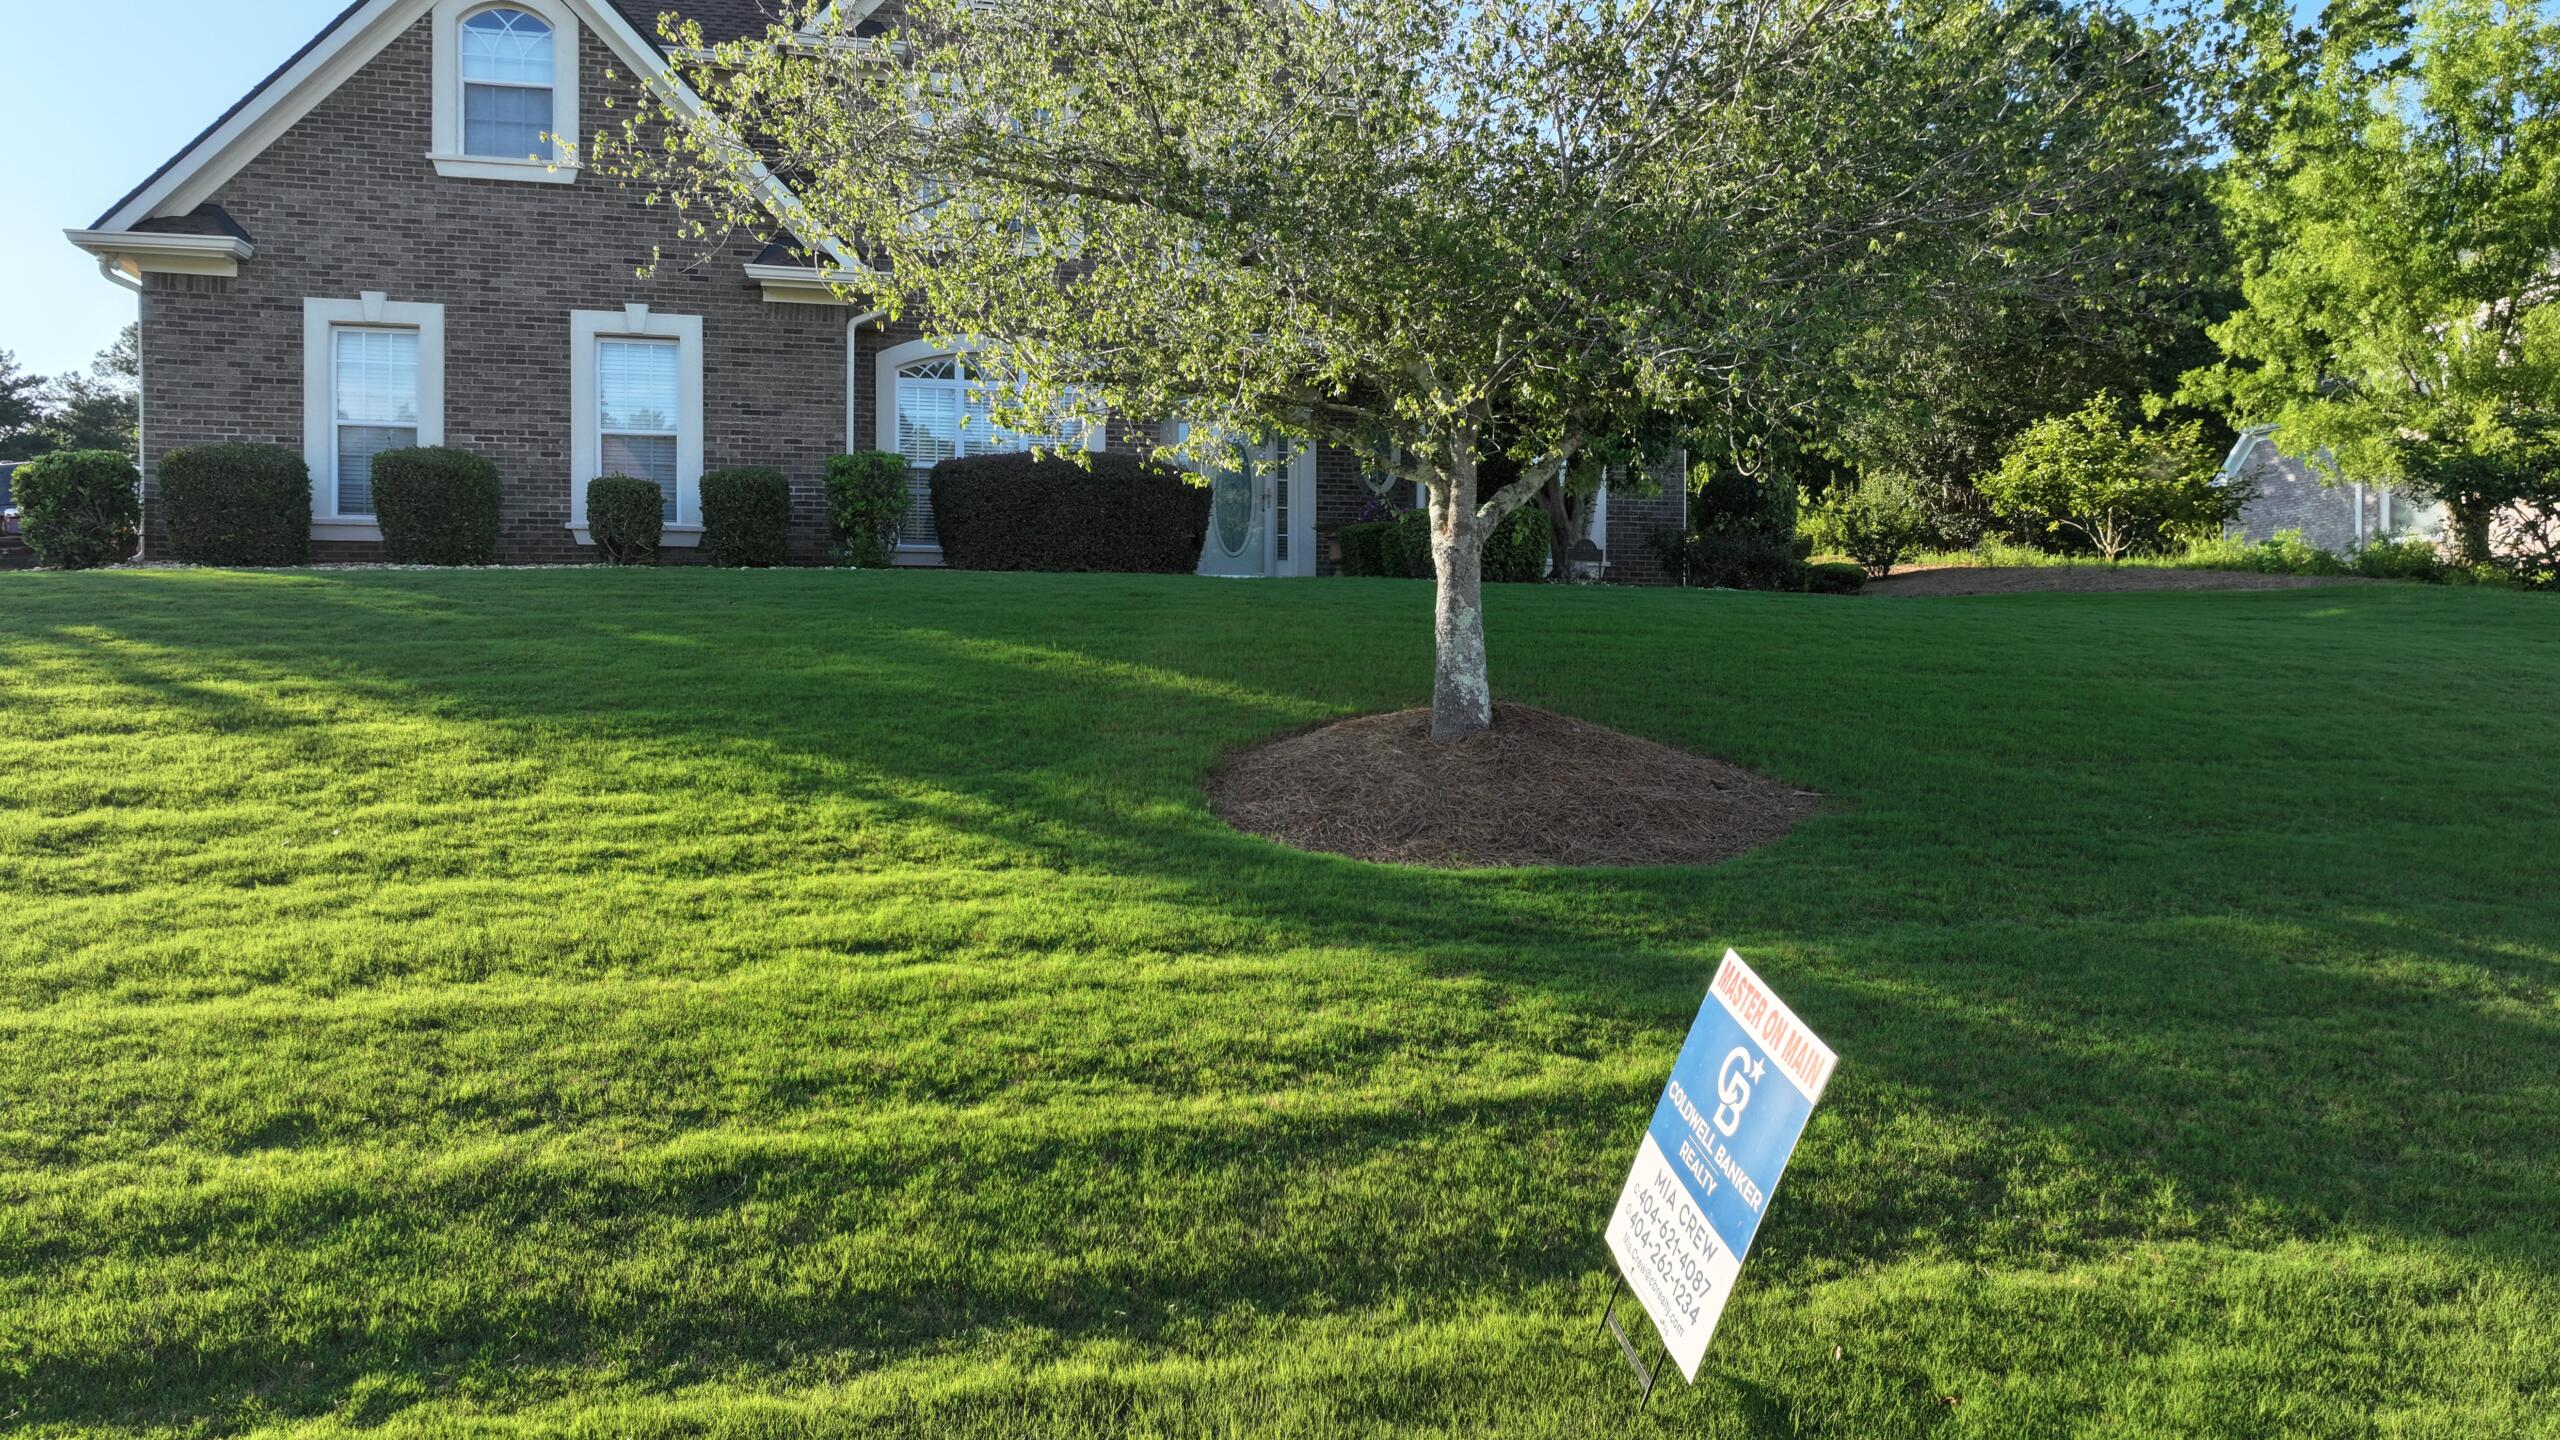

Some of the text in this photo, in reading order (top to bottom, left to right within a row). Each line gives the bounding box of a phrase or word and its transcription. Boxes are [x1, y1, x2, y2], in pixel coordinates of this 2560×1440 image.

[1717, 960, 1825, 1090] MASTER ON MAIN
[1668, 1080, 1763, 1213] COLDWELL BANKER
[1679, 1140, 1718, 1196] REALTY
[1654, 1168, 1718, 1264] MIA CREW
